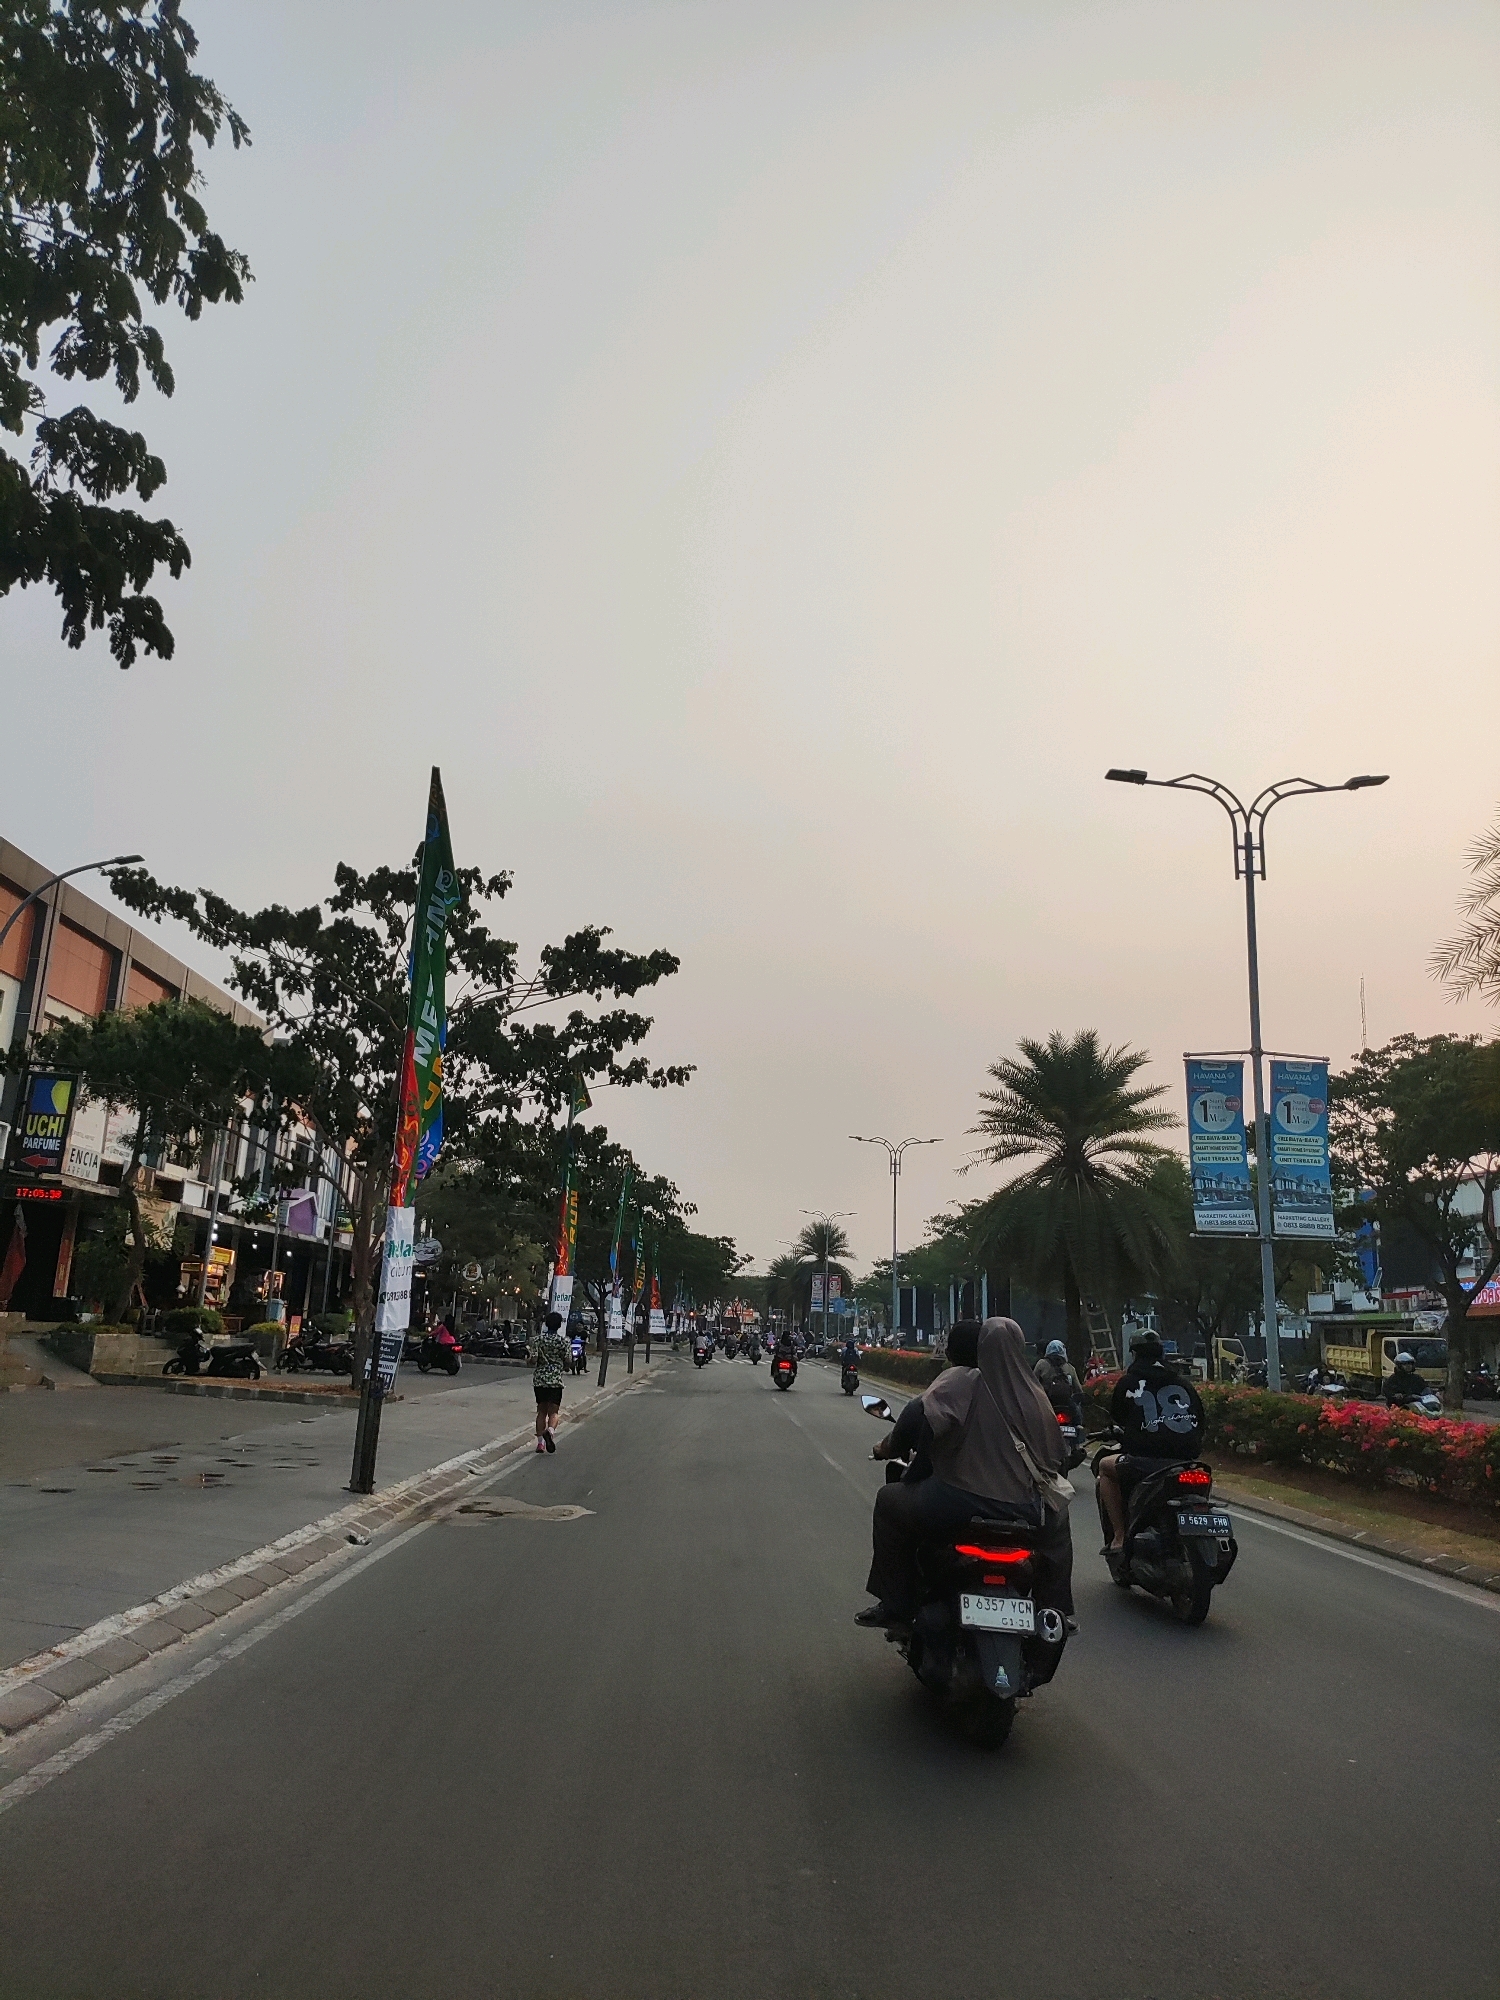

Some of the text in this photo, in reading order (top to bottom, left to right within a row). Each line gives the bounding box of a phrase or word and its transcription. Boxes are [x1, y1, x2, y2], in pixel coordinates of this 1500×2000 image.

[1193, 1072, 1227, 1080] HAVANA
[1277, 1073, 1311, 1081] HAVANA
[26, 1114, 65, 1137] UCHI
[22, 1137, 61, 1151] PARFUME
[69, 1148, 98, 1169] ENCIA
[1316, 1223, 1333, 1231] 8202
[1133, 1384, 1193, 1434] 18
[1140, 1415, 1166, 1431] Night
[1180, 1515, 1186, 1525] B
[1188, 1516, 1208, 1526] 5629
[963, 1596, 1032, 1614] B 6357 YCN
